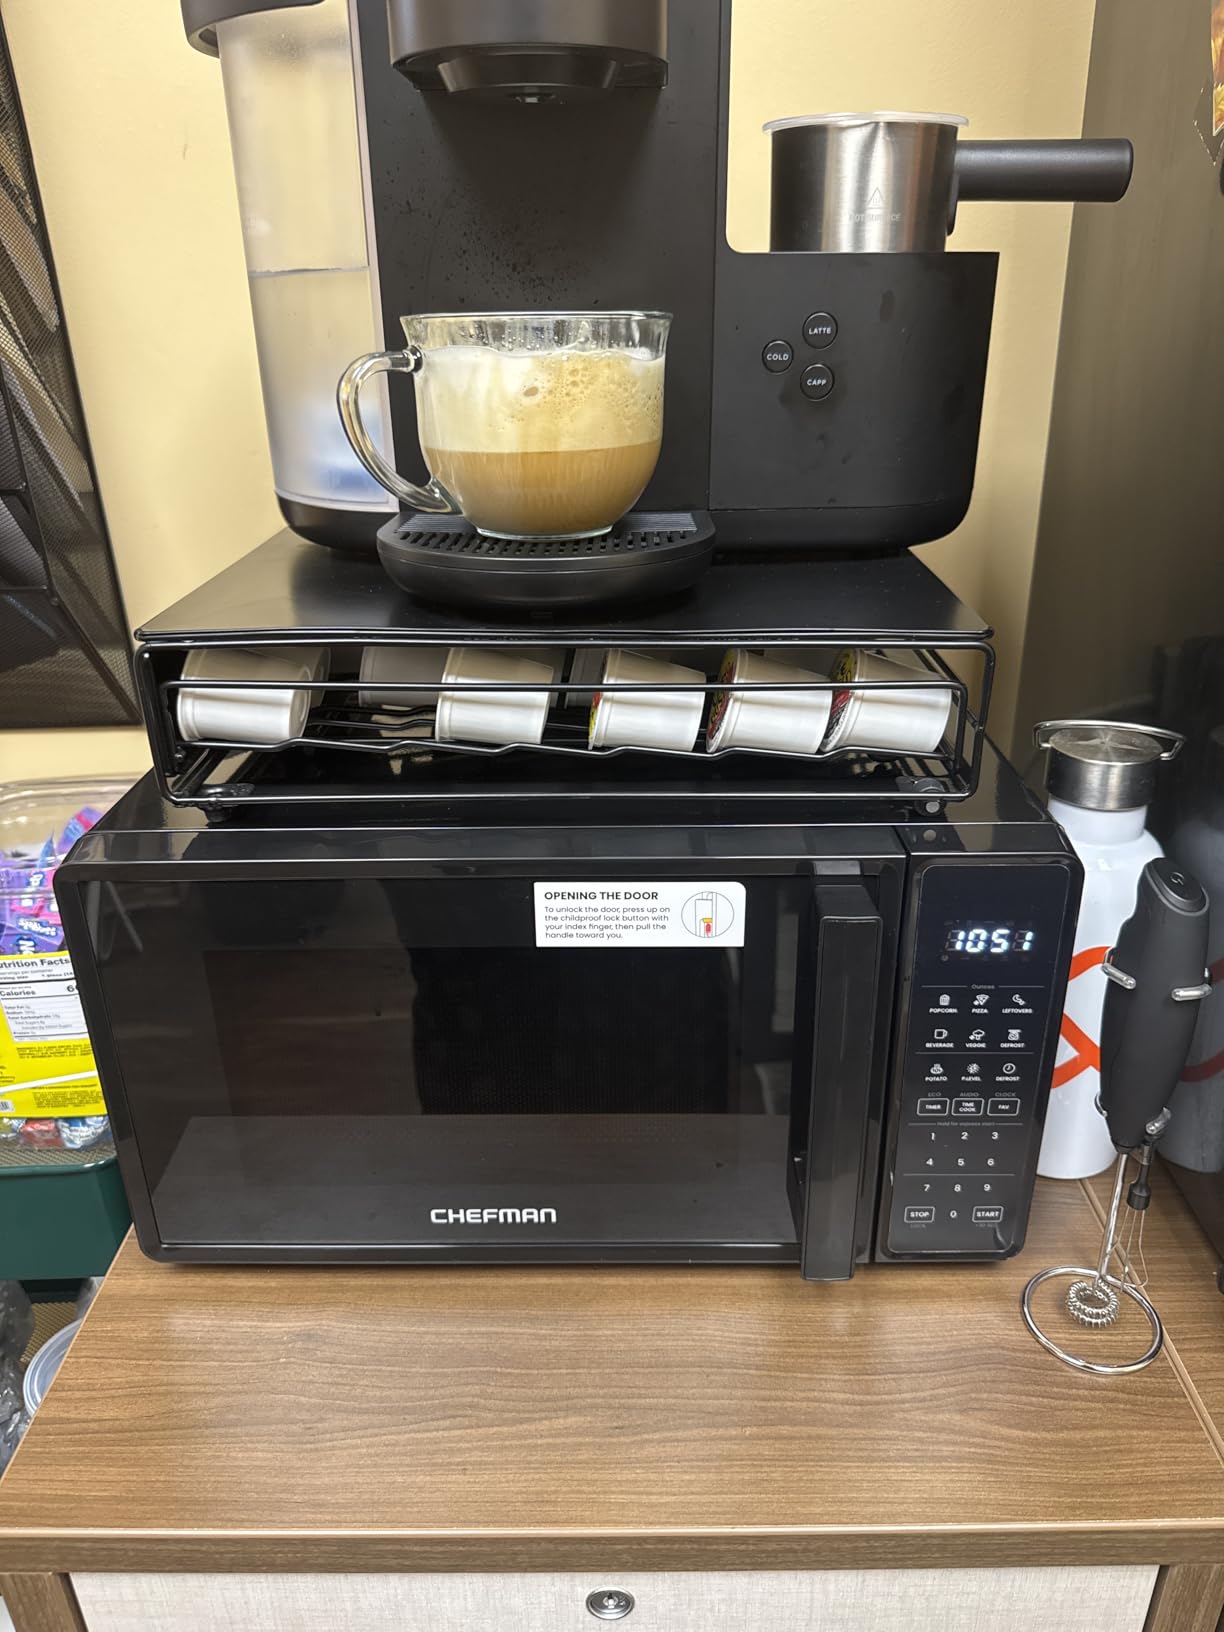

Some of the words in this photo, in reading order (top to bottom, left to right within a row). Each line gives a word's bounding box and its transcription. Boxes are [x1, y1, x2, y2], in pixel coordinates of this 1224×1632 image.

[808, 327, 832, 335] LATTE
[766, 353, 789, 361] COLD
[544, 891, 597, 900] OPENING
[599, 891, 622, 900] THE
[624, 891, 659, 900] DOOR
[600, 906, 621, 914] door,
[622, 907, 645, 915] press
[647, 907, 658, 915] up
[544, 914, 558, 922] the
[560, 914, 601, 924] childproof
[603, 914, 620, 922] lock
[622, 914, 651, 922] button
[652, 914, 669, 922] with
[589, 923, 613, 932] finger,
[636, 923, 651, 932] pull
[545, 931, 574, 939] handle
[576, 931, 604, 939] toward
[40, 957, 71, 967] Facts
[0, 989, 36, 997] Calories
[66, 984, 79, 993] 6
[930, 1132, 936, 1141] 1
[960, 1131, 969, 1140] 2
[991, 1131, 999, 1140] 3
[925, 1157, 934, 1166] 4
[957, 1158, 965, 1166] 5
[986, 1158, 995, 1166] 6
[923, 1183, 930, 1192] 7
[953, 1183, 961, 1192] 8
[983, 1183, 991, 1192] 9
[430, 1207, 557, 1224] CHEFMAN
[949, 1210, 957, 1218] 0
